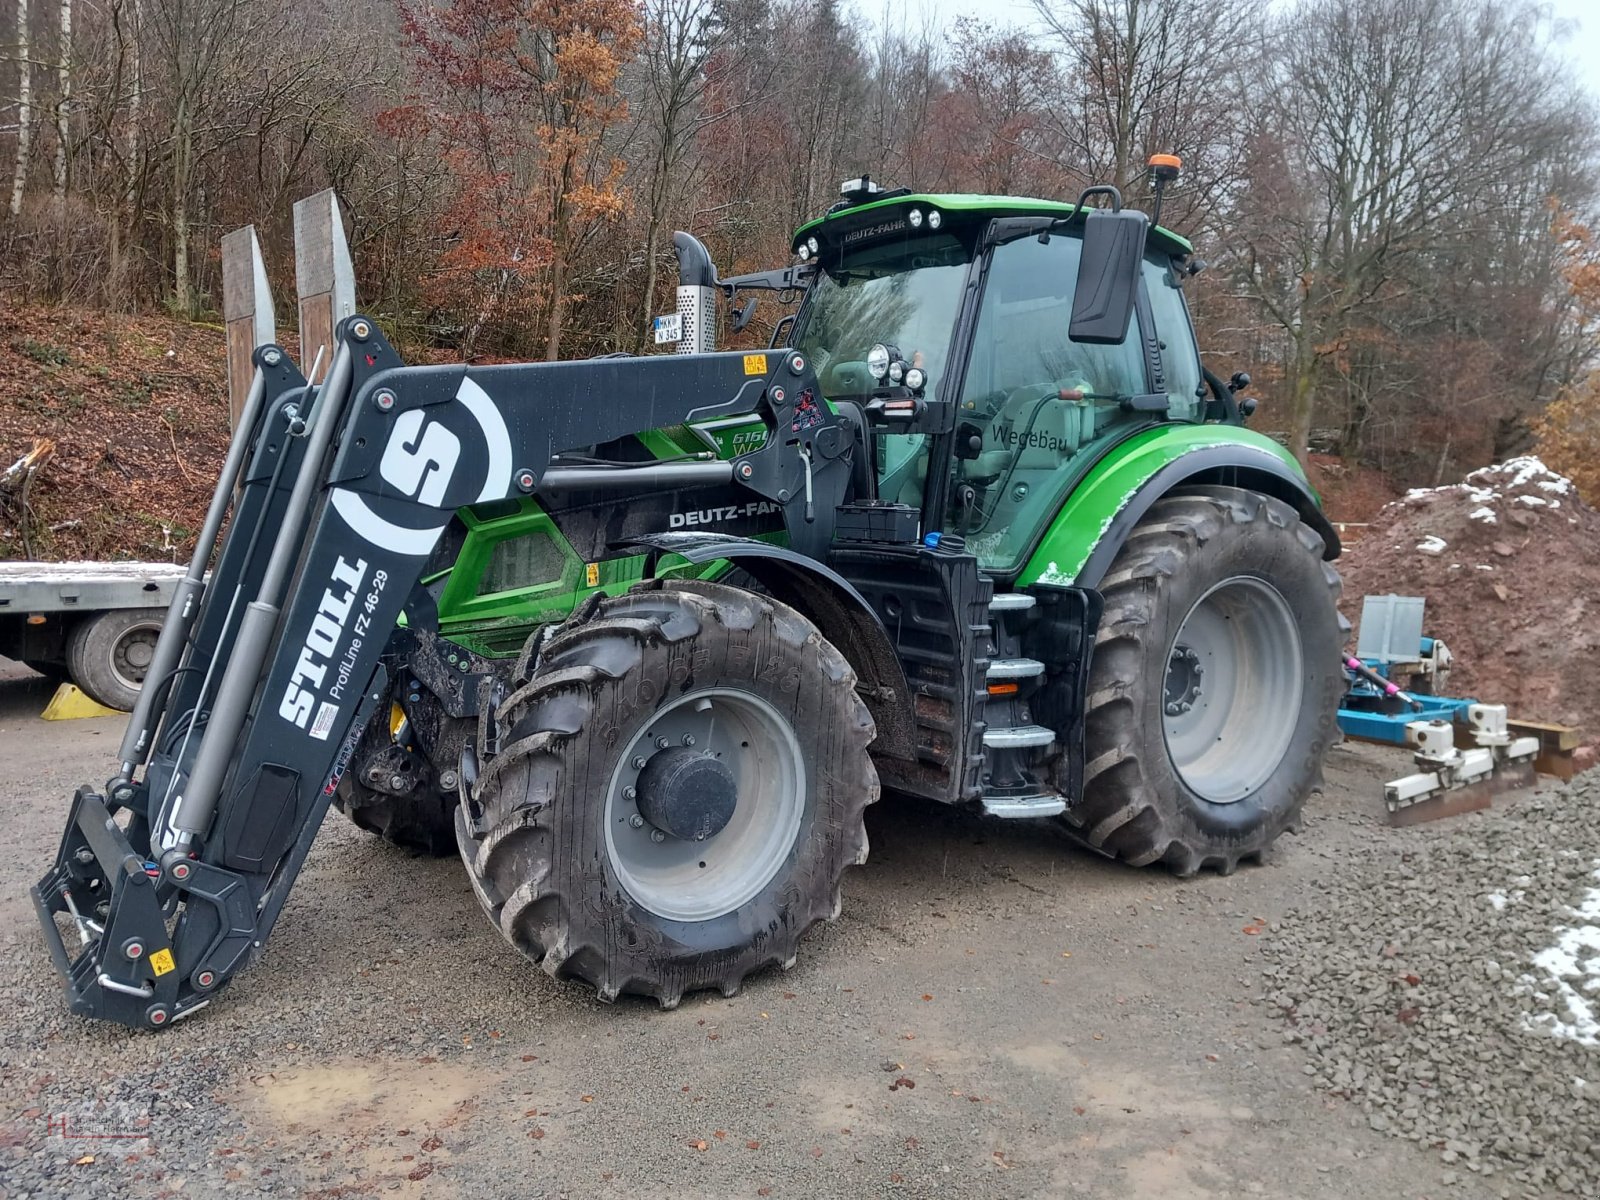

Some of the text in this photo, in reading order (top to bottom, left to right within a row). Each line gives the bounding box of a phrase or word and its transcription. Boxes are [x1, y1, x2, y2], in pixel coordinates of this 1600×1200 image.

[845, 220, 906, 242] DEUTZ-FAHR
[666, 328, 678, 341] 345
[380, 408, 461, 508] S
[992, 424, 1068, 452] Wegebau
[279, 555, 368, 729] STOLL
[330, 638, 362, 700] ProfiLine
[354, 613, 371, 636] FZ
[364, 569, 388, 614] 46-29
